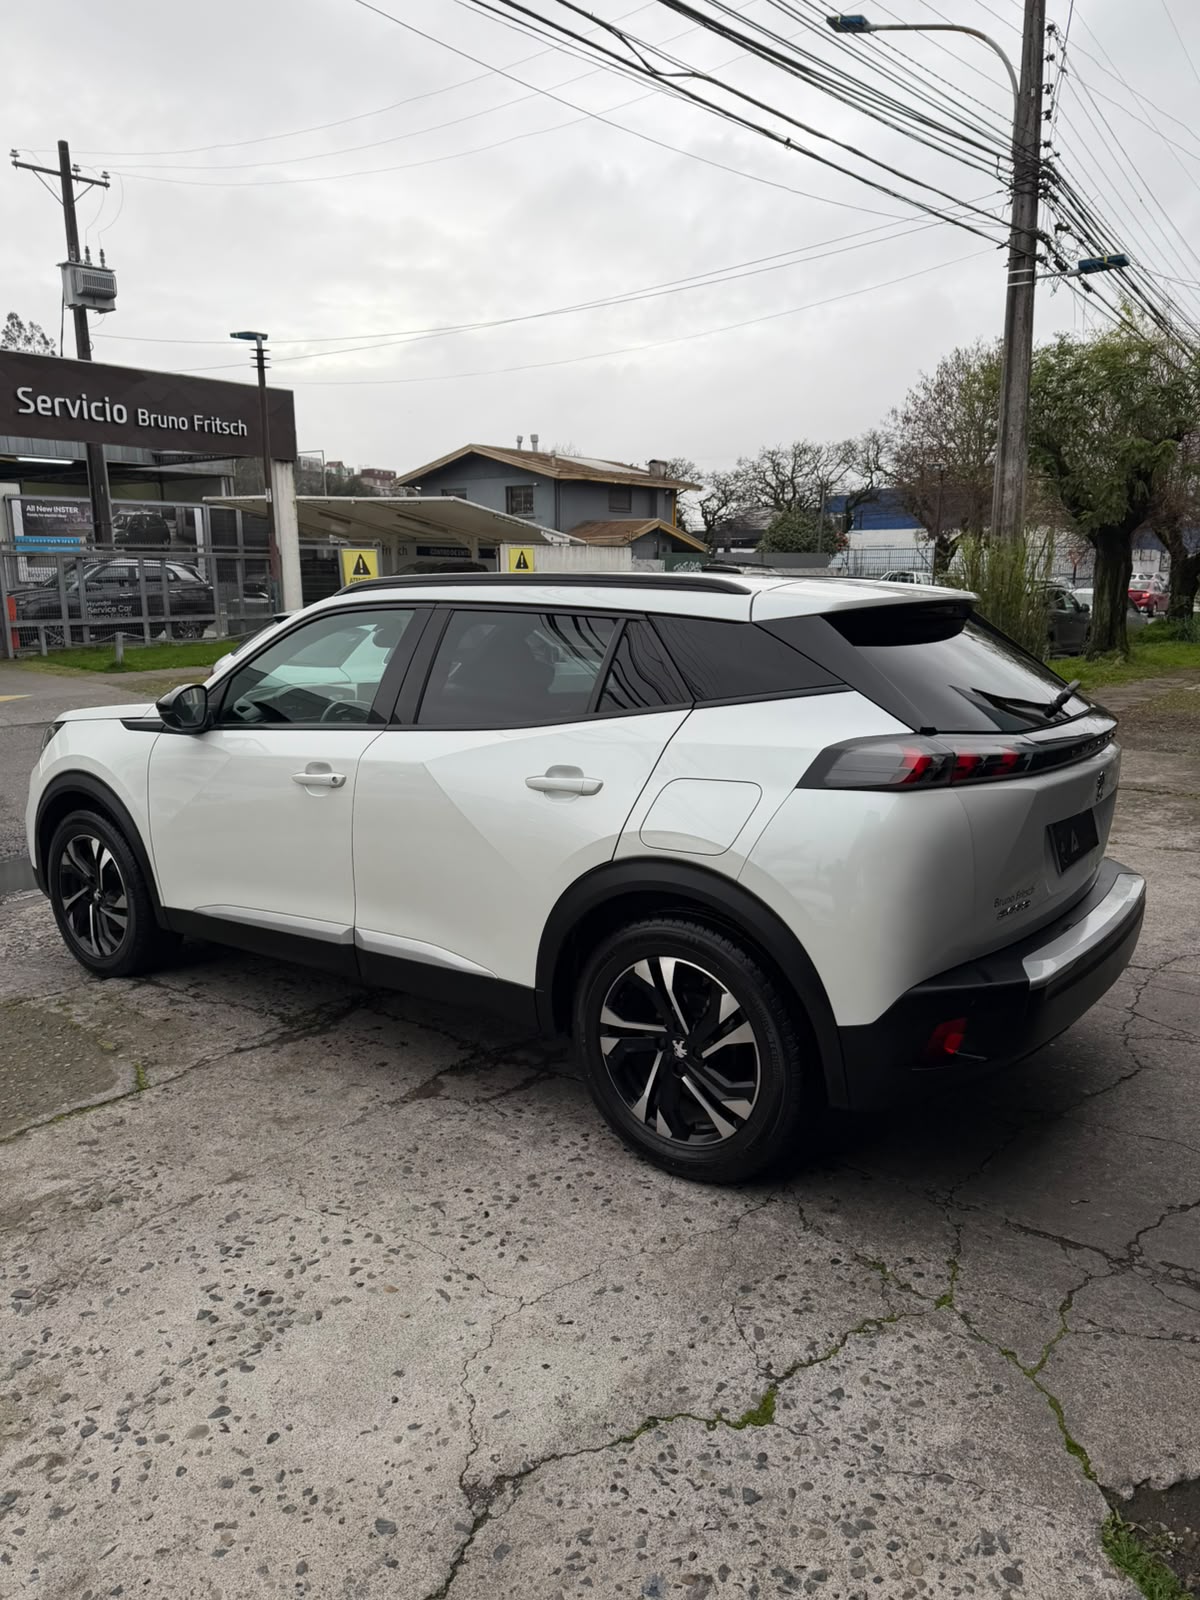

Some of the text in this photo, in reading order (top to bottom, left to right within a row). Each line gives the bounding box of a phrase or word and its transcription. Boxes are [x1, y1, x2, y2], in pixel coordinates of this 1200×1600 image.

[16, 386, 248, 437] Servicio Bruno Fritsch
